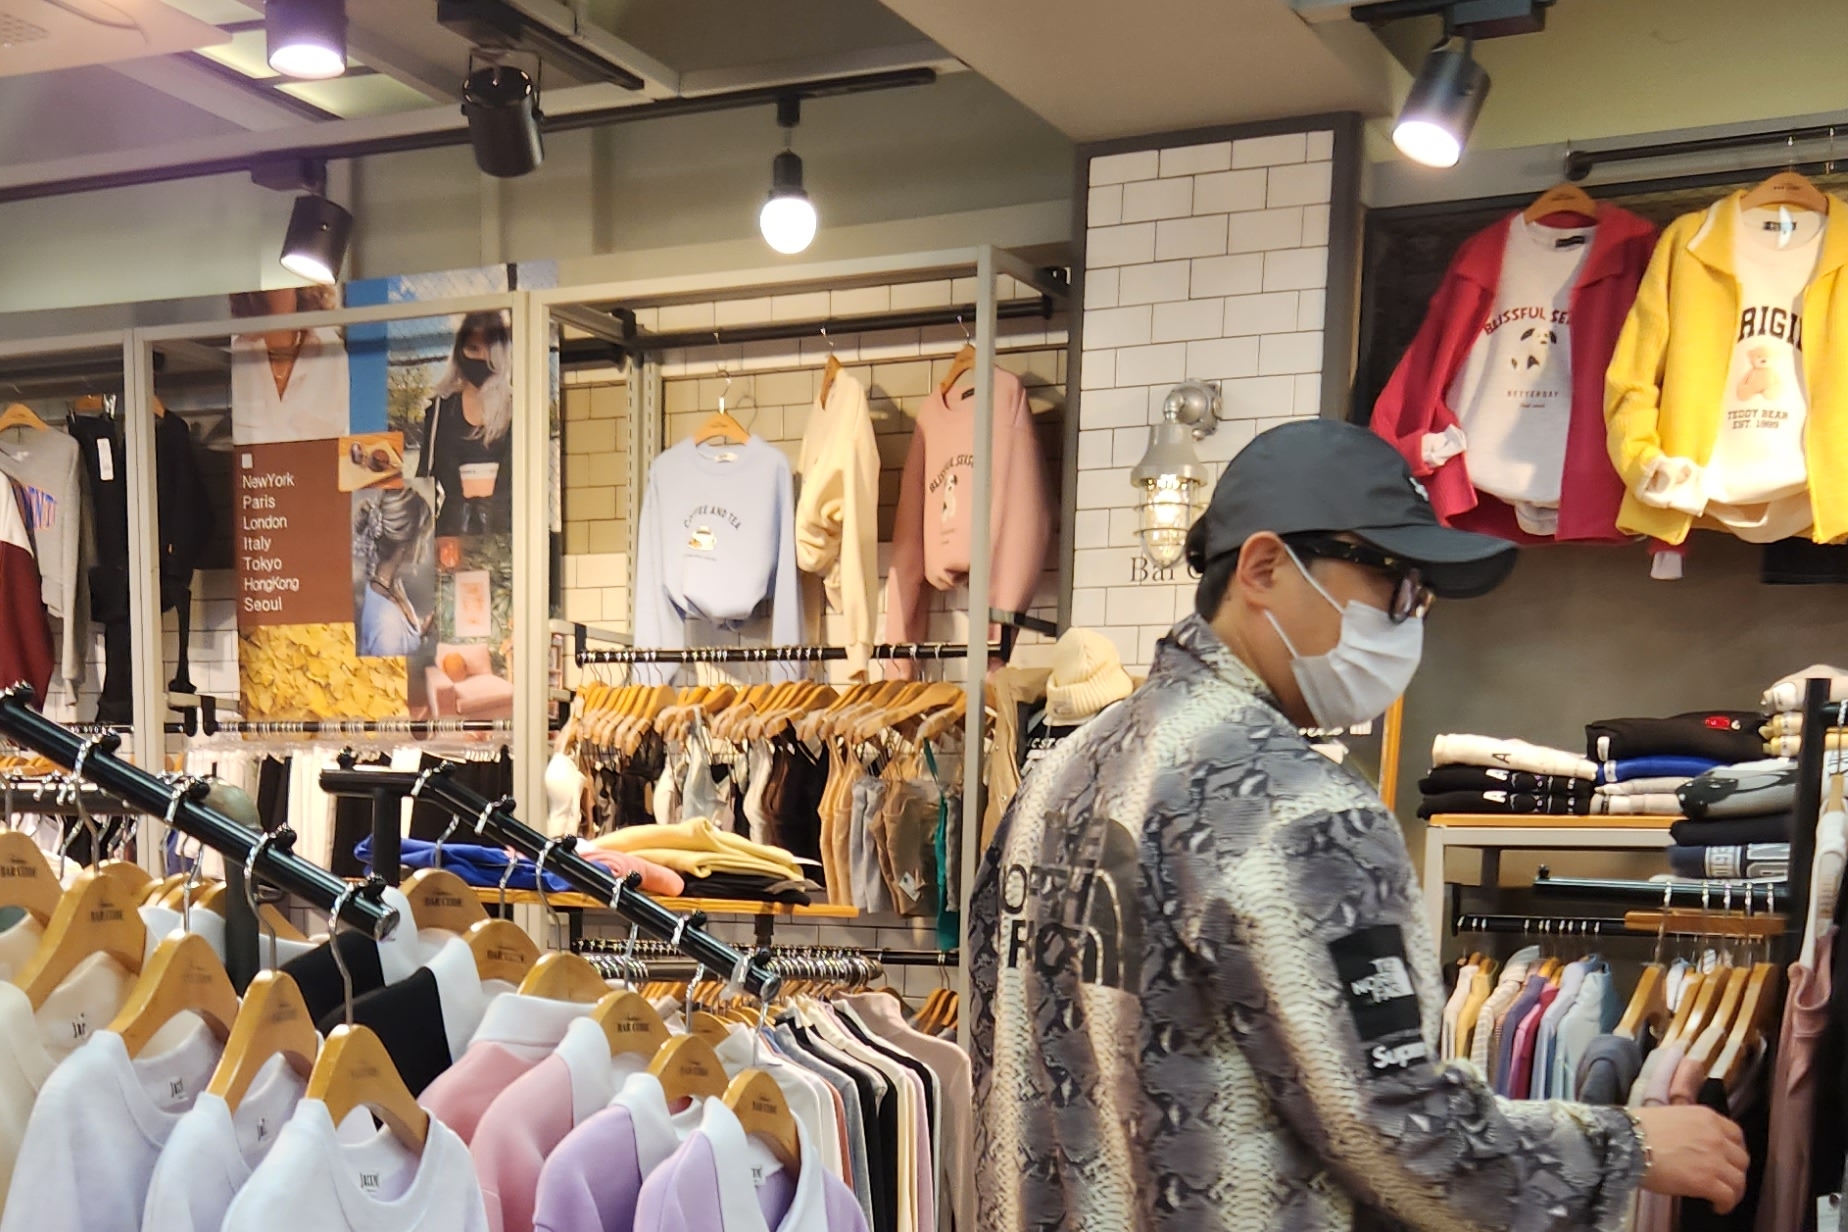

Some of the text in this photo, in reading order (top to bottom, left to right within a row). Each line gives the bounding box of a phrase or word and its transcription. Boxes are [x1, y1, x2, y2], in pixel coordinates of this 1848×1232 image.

[1484, 307, 1569, 335] BLISSFUL SE
[1727, 408, 1759, 420] TEDDY
[242, 472, 295, 489] NewYork
[243, 494, 276, 510] Paris
[243, 516, 288, 531] London
[243, 536, 272, 552] Italy
[243, 557, 283, 573] Tokyo
[244, 577, 300, 593] HongKong
[244, 597, 283, 612] Seoul
